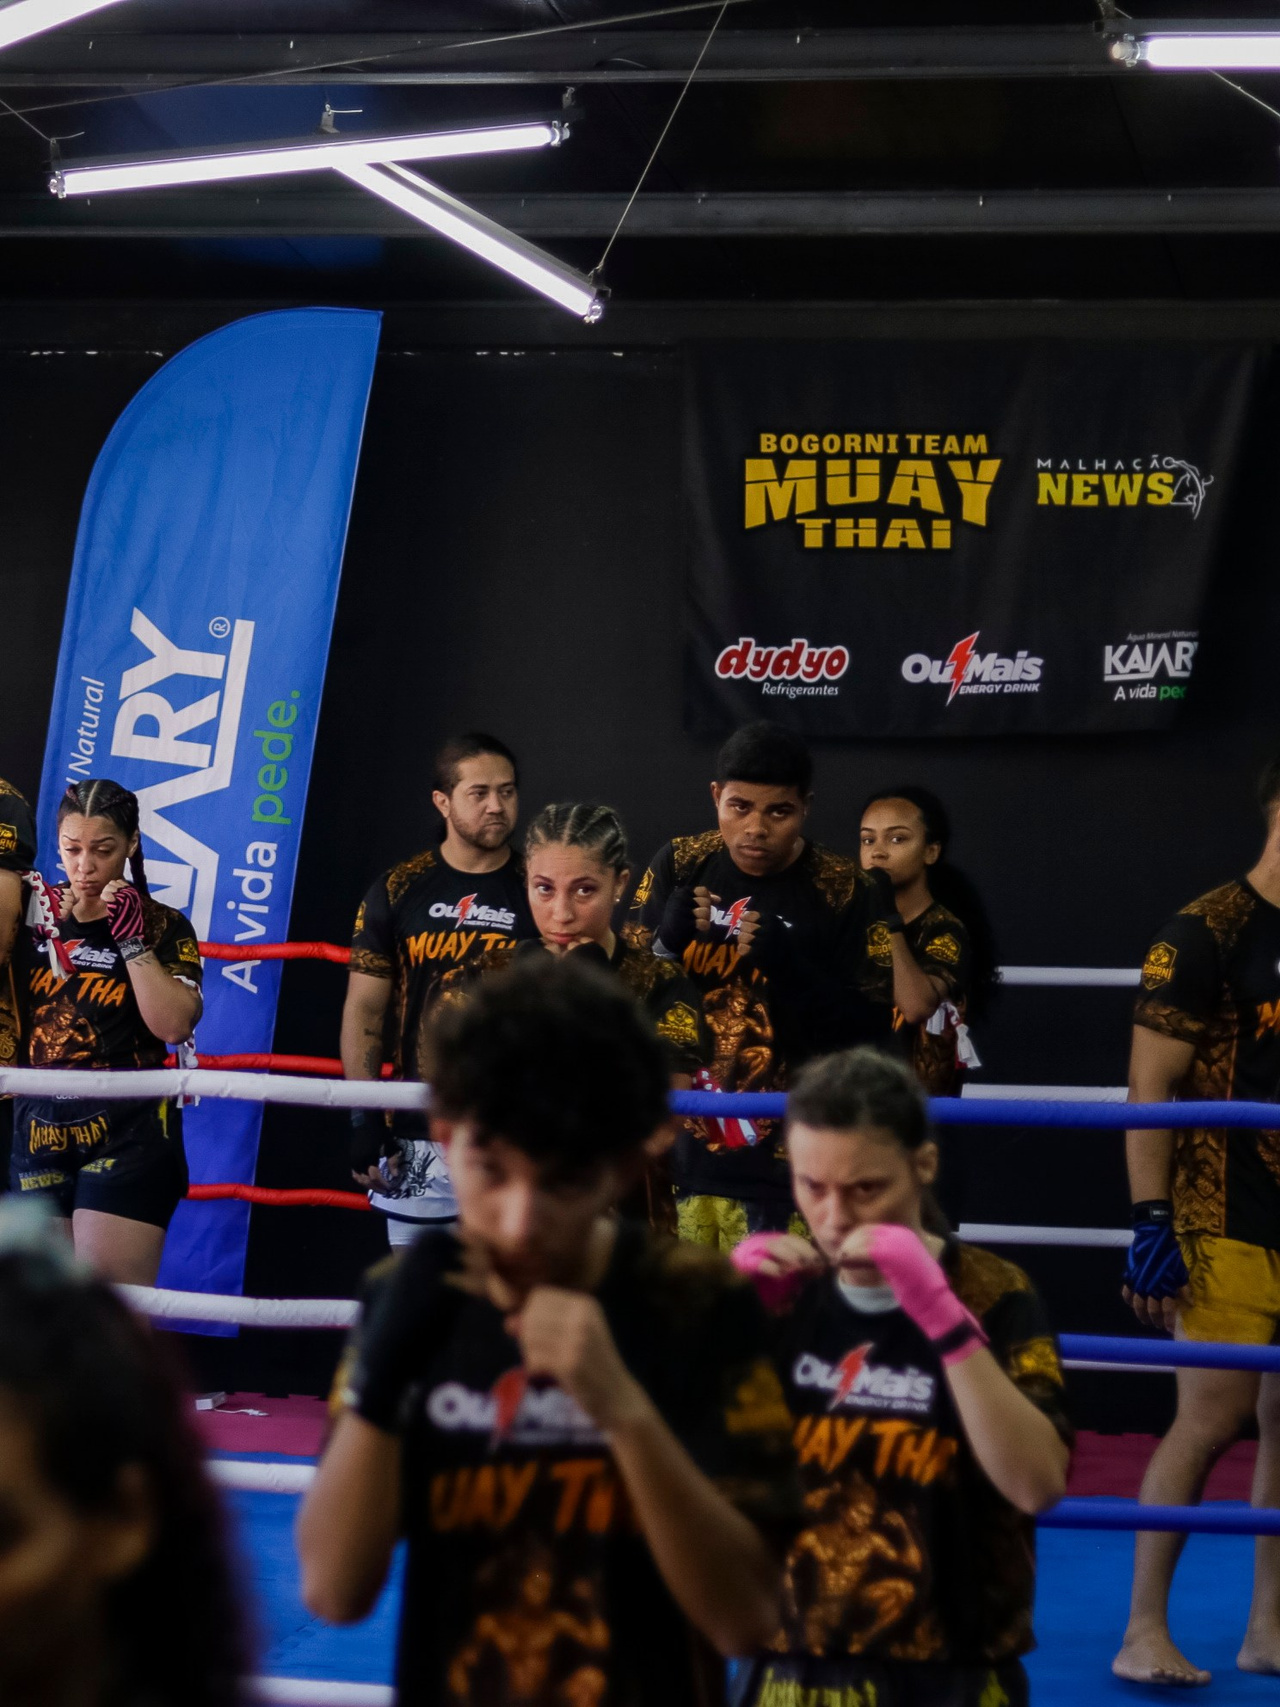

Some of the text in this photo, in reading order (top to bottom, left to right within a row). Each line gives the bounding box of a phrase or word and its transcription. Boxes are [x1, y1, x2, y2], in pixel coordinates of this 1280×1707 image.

[760, 433, 988, 454] BOGORNI TEAM
[1037, 454, 1174, 471] MALHAÇÃO
[744, 458, 1002, 529] MUAY
[1037, 472, 1174, 506] NEWS
[796, 518, 951, 549] THAI
[715, 637, 849, 682] dydyo
[762, 682, 839, 699] Refrigerantes
[959, 683, 1040, 694] ENERGY DRINK
[1114, 686, 1126, 701] A
[1130, 683, 1157, 699] vida
[68, 676, 106, 776] Natural
[222, 690, 301, 993] A vida pede.
[406, 931, 477, 969] MUAY
